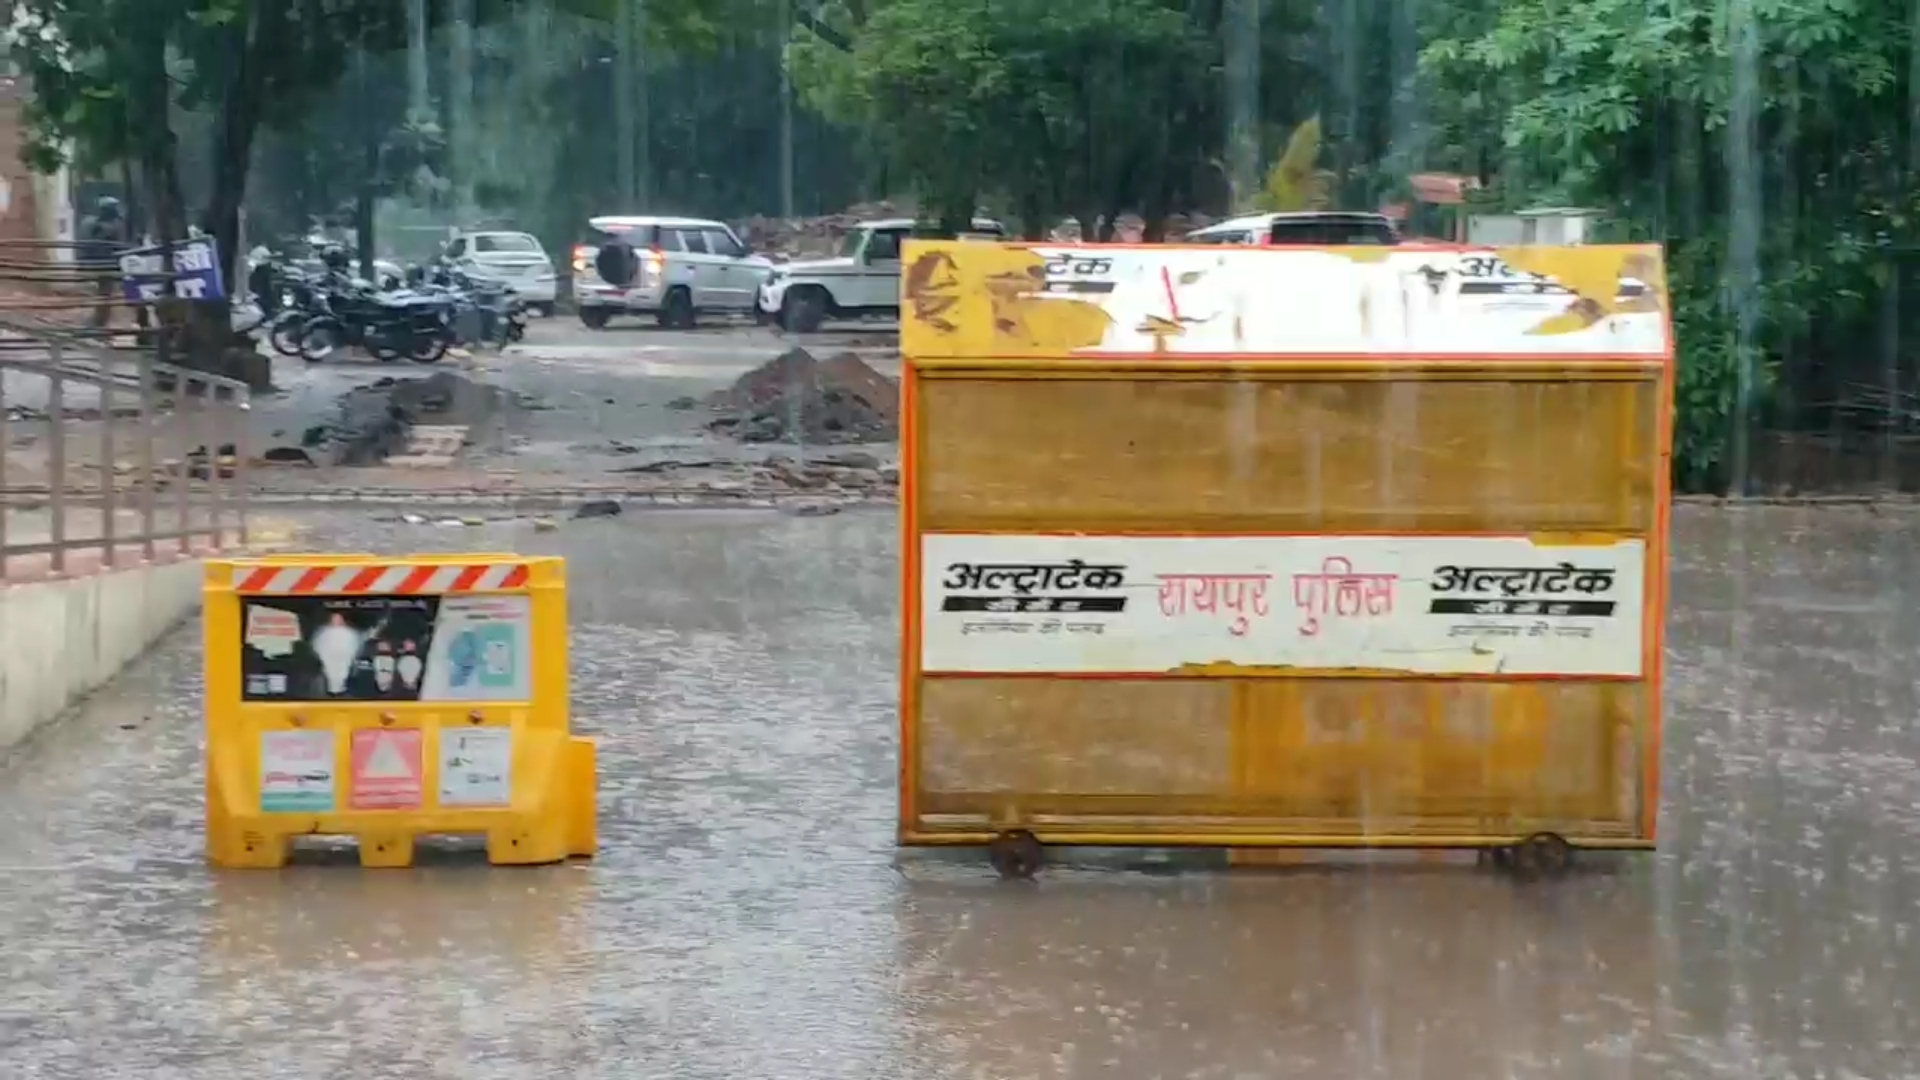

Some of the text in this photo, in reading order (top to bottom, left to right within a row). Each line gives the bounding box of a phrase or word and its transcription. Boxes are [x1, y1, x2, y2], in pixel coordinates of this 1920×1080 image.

[943, 559, 1128, 594] अल्ट्राटेक
[1430, 562, 1616, 596] अल्ट्राटेक
[1154, 556, 1397, 636] रायपुर पुलिस
